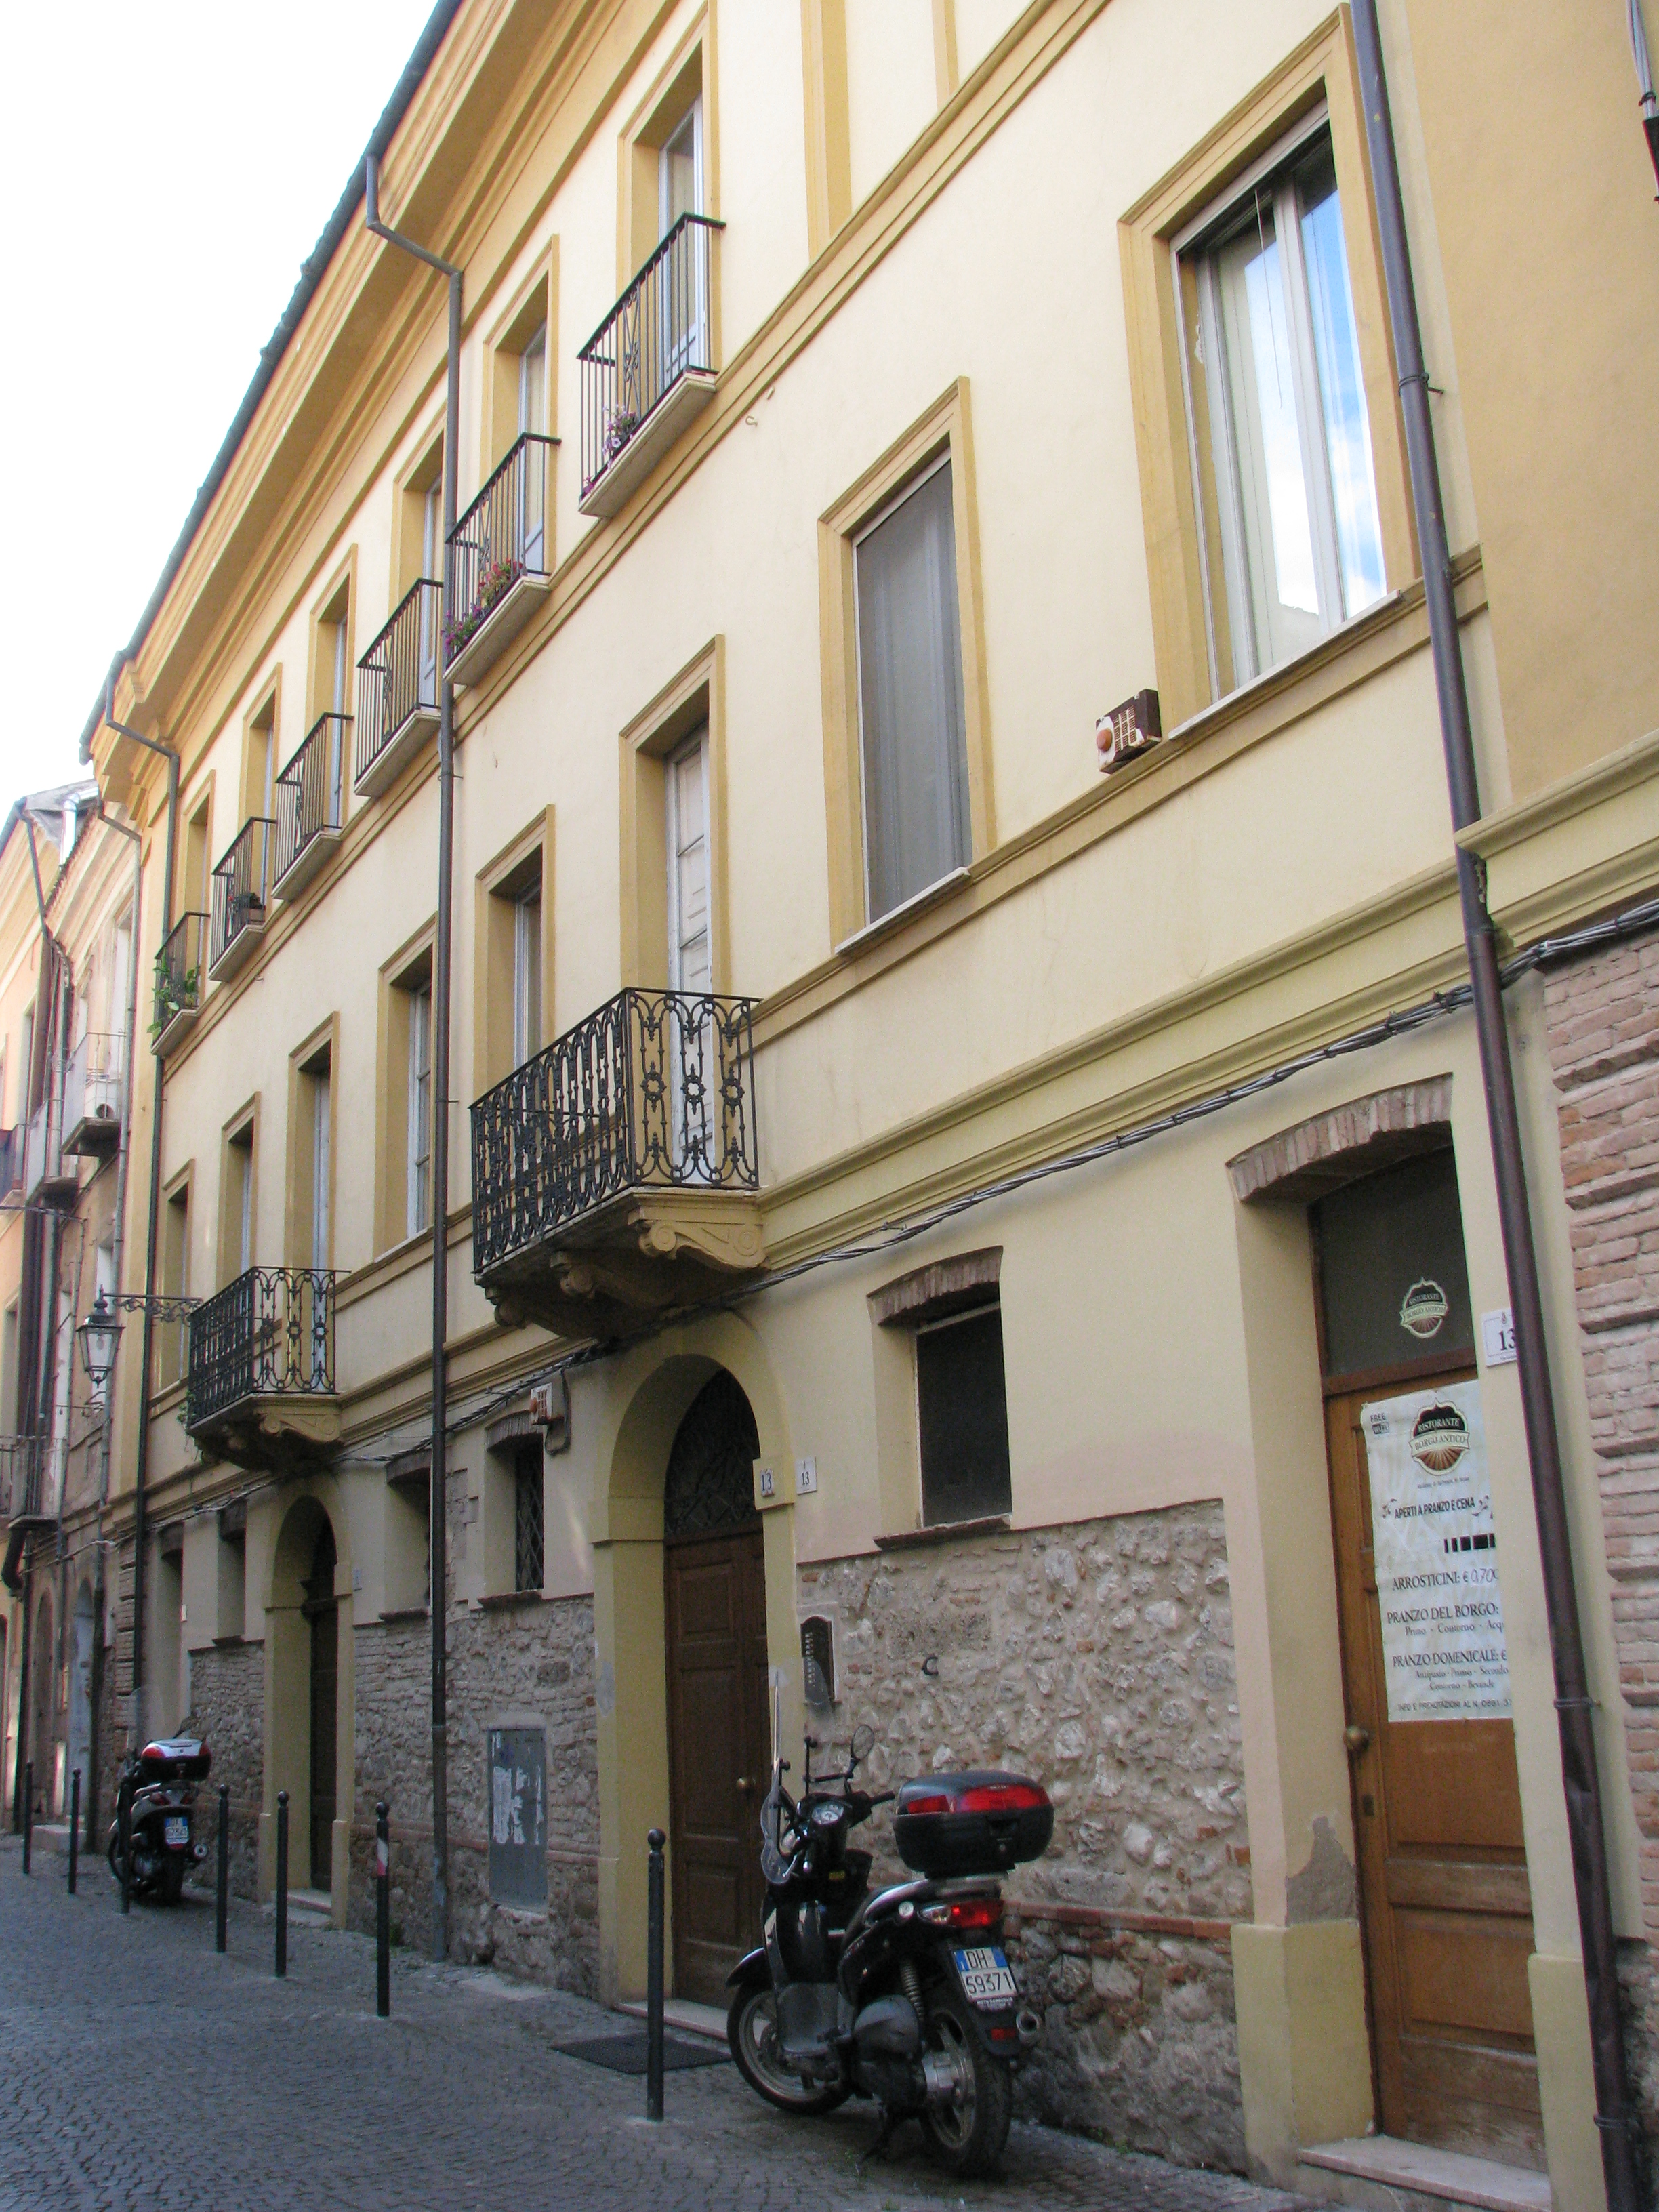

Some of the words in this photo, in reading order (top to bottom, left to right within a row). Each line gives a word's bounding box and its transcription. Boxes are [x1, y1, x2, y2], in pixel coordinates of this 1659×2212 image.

[1370, 1412, 1387, 1422] FREE
[1418, 1417, 1460, 1432] RISTORANTE
[1414, 1436, 1438, 1450] BORGO
[1439, 1434, 1465, 1443] ANTICO
[762, 1473, 772, 1491] 13
[802, 1471, 810, 1486] 13
[1395, 1505, 1417, 1519] APERTI
[1418, 1504, 1423, 1515] A
[1424, 1500, 1450, 1514] PRANZO
[1451, 1499, 1456, 1511] E
[1456, 1496, 1475, 1510] CENA
[1393, 1570, 1460, 1591] ARROSTICINI:
[1387, 1608, 1429, 1624] PRANZO
[1431, 1605, 1453, 1620] DEL
[1454, 1602, 1499, 1618] BORGO:
[1487, 1620, 1504, 1633] Acq
[1392, 1653, 1431, 1668] PRANZO
[1432, 1649, 1499, 1665] DOMENICALE:
[967, 1949, 989, 1968] DH
[966, 1971, 1012, 1993] 59371
